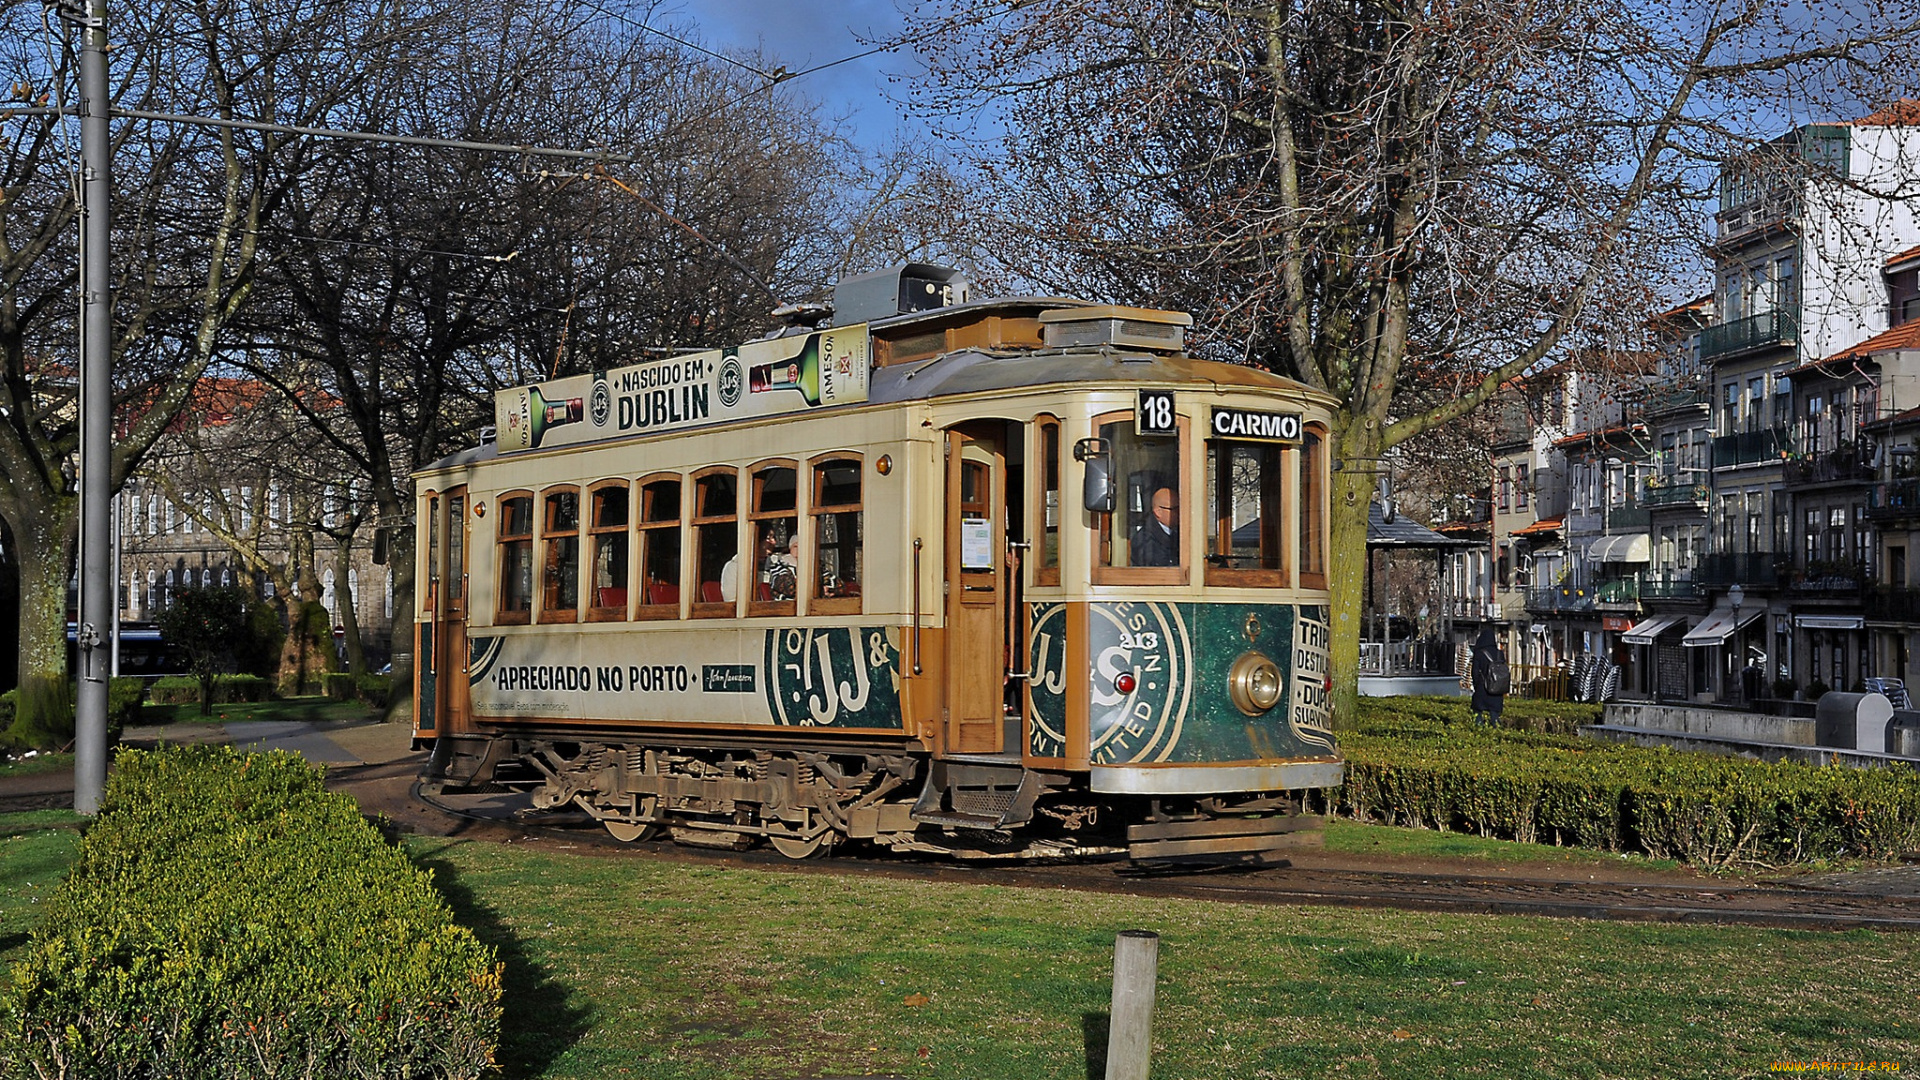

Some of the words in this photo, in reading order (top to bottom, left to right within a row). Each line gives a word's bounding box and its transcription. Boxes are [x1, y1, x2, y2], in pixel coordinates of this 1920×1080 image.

[622, 364, 681, 393] NASCIDO
[684, 358, 705, 382] EM
[823, 335, 835, 400] JAMESON
[518, 392, 529, 446] JAMESON
[618, 383, 709, 431] DUBLIN
[1144, 396, 1172, 429] 18
[1215, 412, 1297, 438] CARMO
[1119, 631, 1159, 650] 213
[1299, 620, 1331, 653] TRIP
[498, 665, 592, 692] APRECIADO
[597, 665, 623, 692] NO
[628, 665, 688, 692] PORTO
